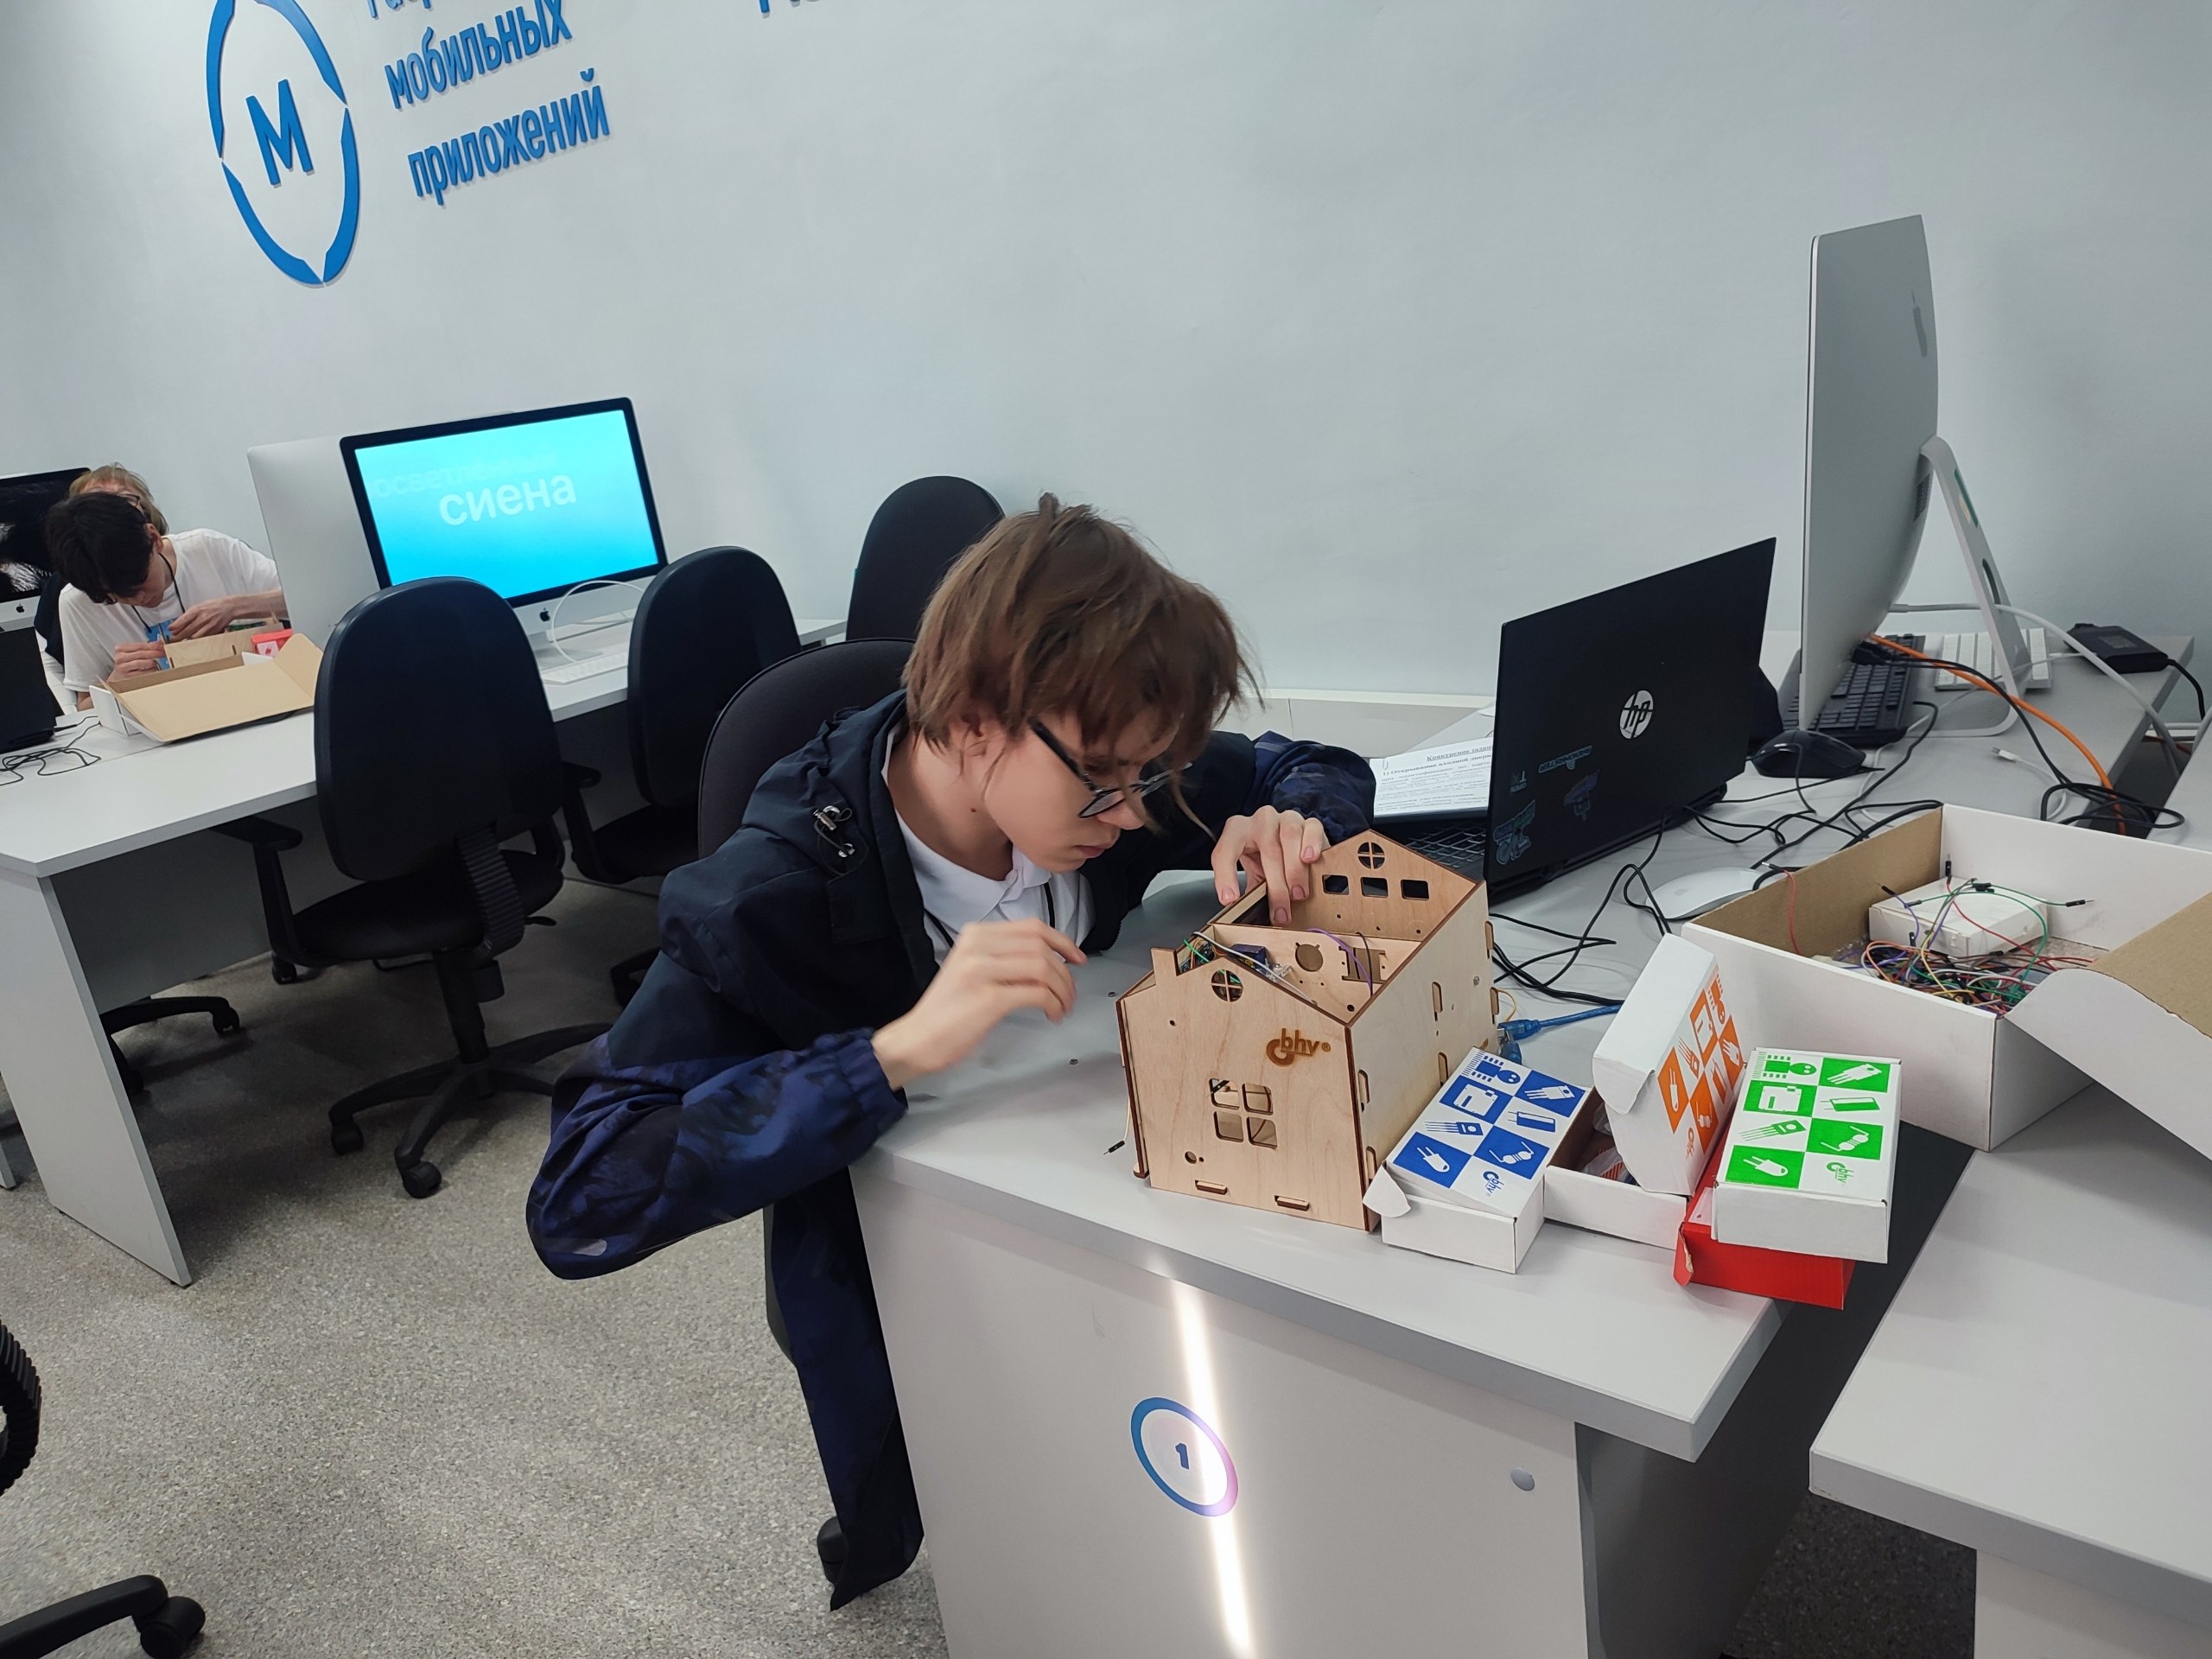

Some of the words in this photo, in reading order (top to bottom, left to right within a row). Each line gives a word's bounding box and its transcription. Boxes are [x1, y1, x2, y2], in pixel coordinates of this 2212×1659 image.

[385, 0, 572, 109] мобильных
[408, 67, 610, 206] приложений
[439, 474, 577, 525] сиена
[1619, 690, 1654, 740] hp
[1426, 748, 1470, 762] Конкурсное
[1174, 1442, 1190, 1471] 1
